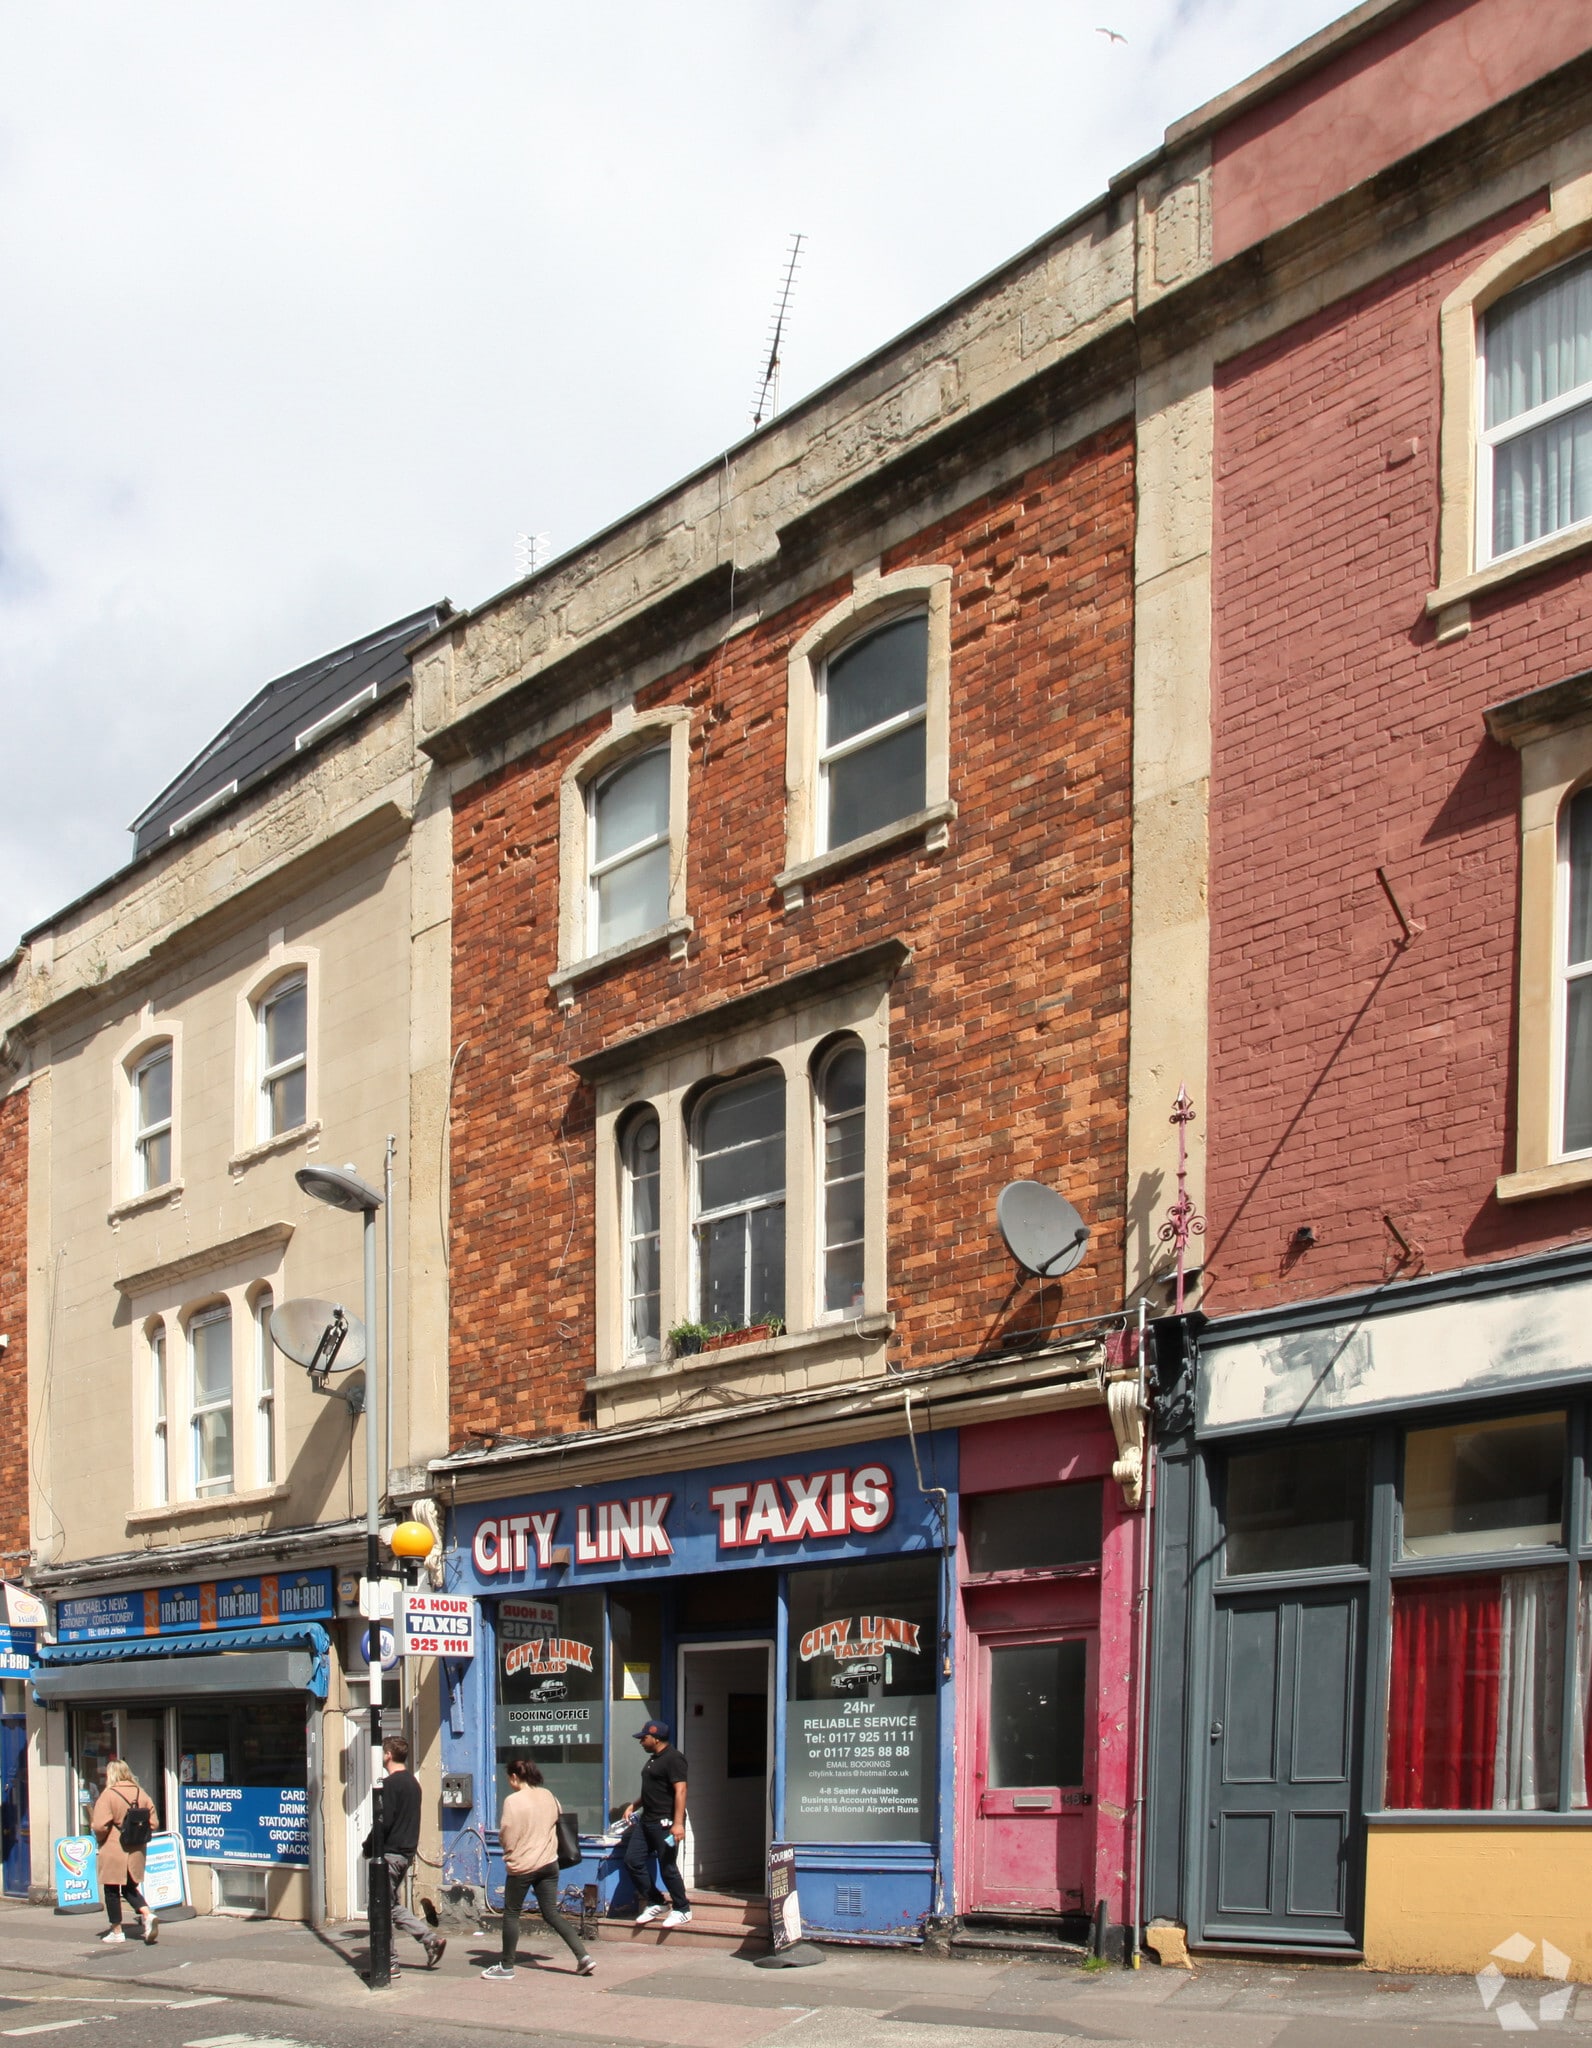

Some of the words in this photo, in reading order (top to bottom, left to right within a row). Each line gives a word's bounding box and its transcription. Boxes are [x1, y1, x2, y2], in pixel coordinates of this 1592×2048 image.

[472, 1509, 561, 1575] CITY
[576, 1493, 674, 1565] LINK
[708, 1463, 893, 1549] TAXIS
[109, 1597, 128, 1611] NEWS
[410, 1598, 426, 1610] 24
[431, 1600, 468, 1613] HOUR
[93, 1612, 134, 1625] CONFECTIONERY
[410, 1616, 469, 1634] TAXIS
[411, 1638, 438, 1651] 925
[444, 1640, 468, 1652] 1111
[800, 1617, 852, 1662] CITY
[860, 1616, 921, 1655] LINK
[506, 1639, 544, 1676] CITY
[549, 1638, 594, 1673] LINK
[832, 1642, 885, 1660] TAXIS
[529, 1661, 568, 1675] TAXIS
[844, 1702, 875, 1714] 24hr
[509, 1711, 553, 1721] BOOKING
[555, 1709, 590, 1720] OFFICE
[533, 1725, 544, 1733] HR
[546, 1724, 578, 1732] SERVICE
[804, 1719, 860, 1729] RELIABLE
[864, 1716, 917, 1728] SERVICE
[510, 1736, 529, 1745] Tel:
[533, 1735, 554, 1744] 925
[559, 1734, 572, 1744] 11
[578, 1734, 591, 1744] 11
[805, 1734, 826, 1744] Tel:
[829, 1733, 856, 1743] 0117
[860, 1732, 880, 1742] 925
[884, 1731, 896, 1742] 11
[902, 1731, 914, 1742] 11
[809, 1750, 821, 1758] or
[824, 1748, 851, 1758] 0117
[854, 1747, 875, 1757] 925
[879, 1747, 892, 1757] 88
[896, 1746, 910, 1757] 88
[809, 1770, 909, 1779] citylink.taxis@hotmail.co.uk
[186, 1789, 209, 1799] NEWS
[211, 1790, 242, 1799] PAPERS
[834, 1787, 859, 1795] Seater
[861, 1787, 899, 1795] Available
[802, 1796, 838, 1804] Business
[840, 1796, 878, 1805] Accounts
[880, 1796, 918, 1805] Welcome
[186, 1802, 232, 1812] MAGAZINES
[832, 1806, 864, 1814] National
[867, 1806, 895, 1815] Airport
[897, 1806, 919, 1814] Runs
[186, 1814, 221, 1825] LOTTERY
[187, 1826, 224, 1838] TOBACCO
[187, 1839, 202, 1849] TOP
[205, 1840, 221, 1850] UPS
[66, 1880, 88, 1890] Play
[64, 1890, 91, 1901] here!
[773, 1884, 789, 1900] HERE!
